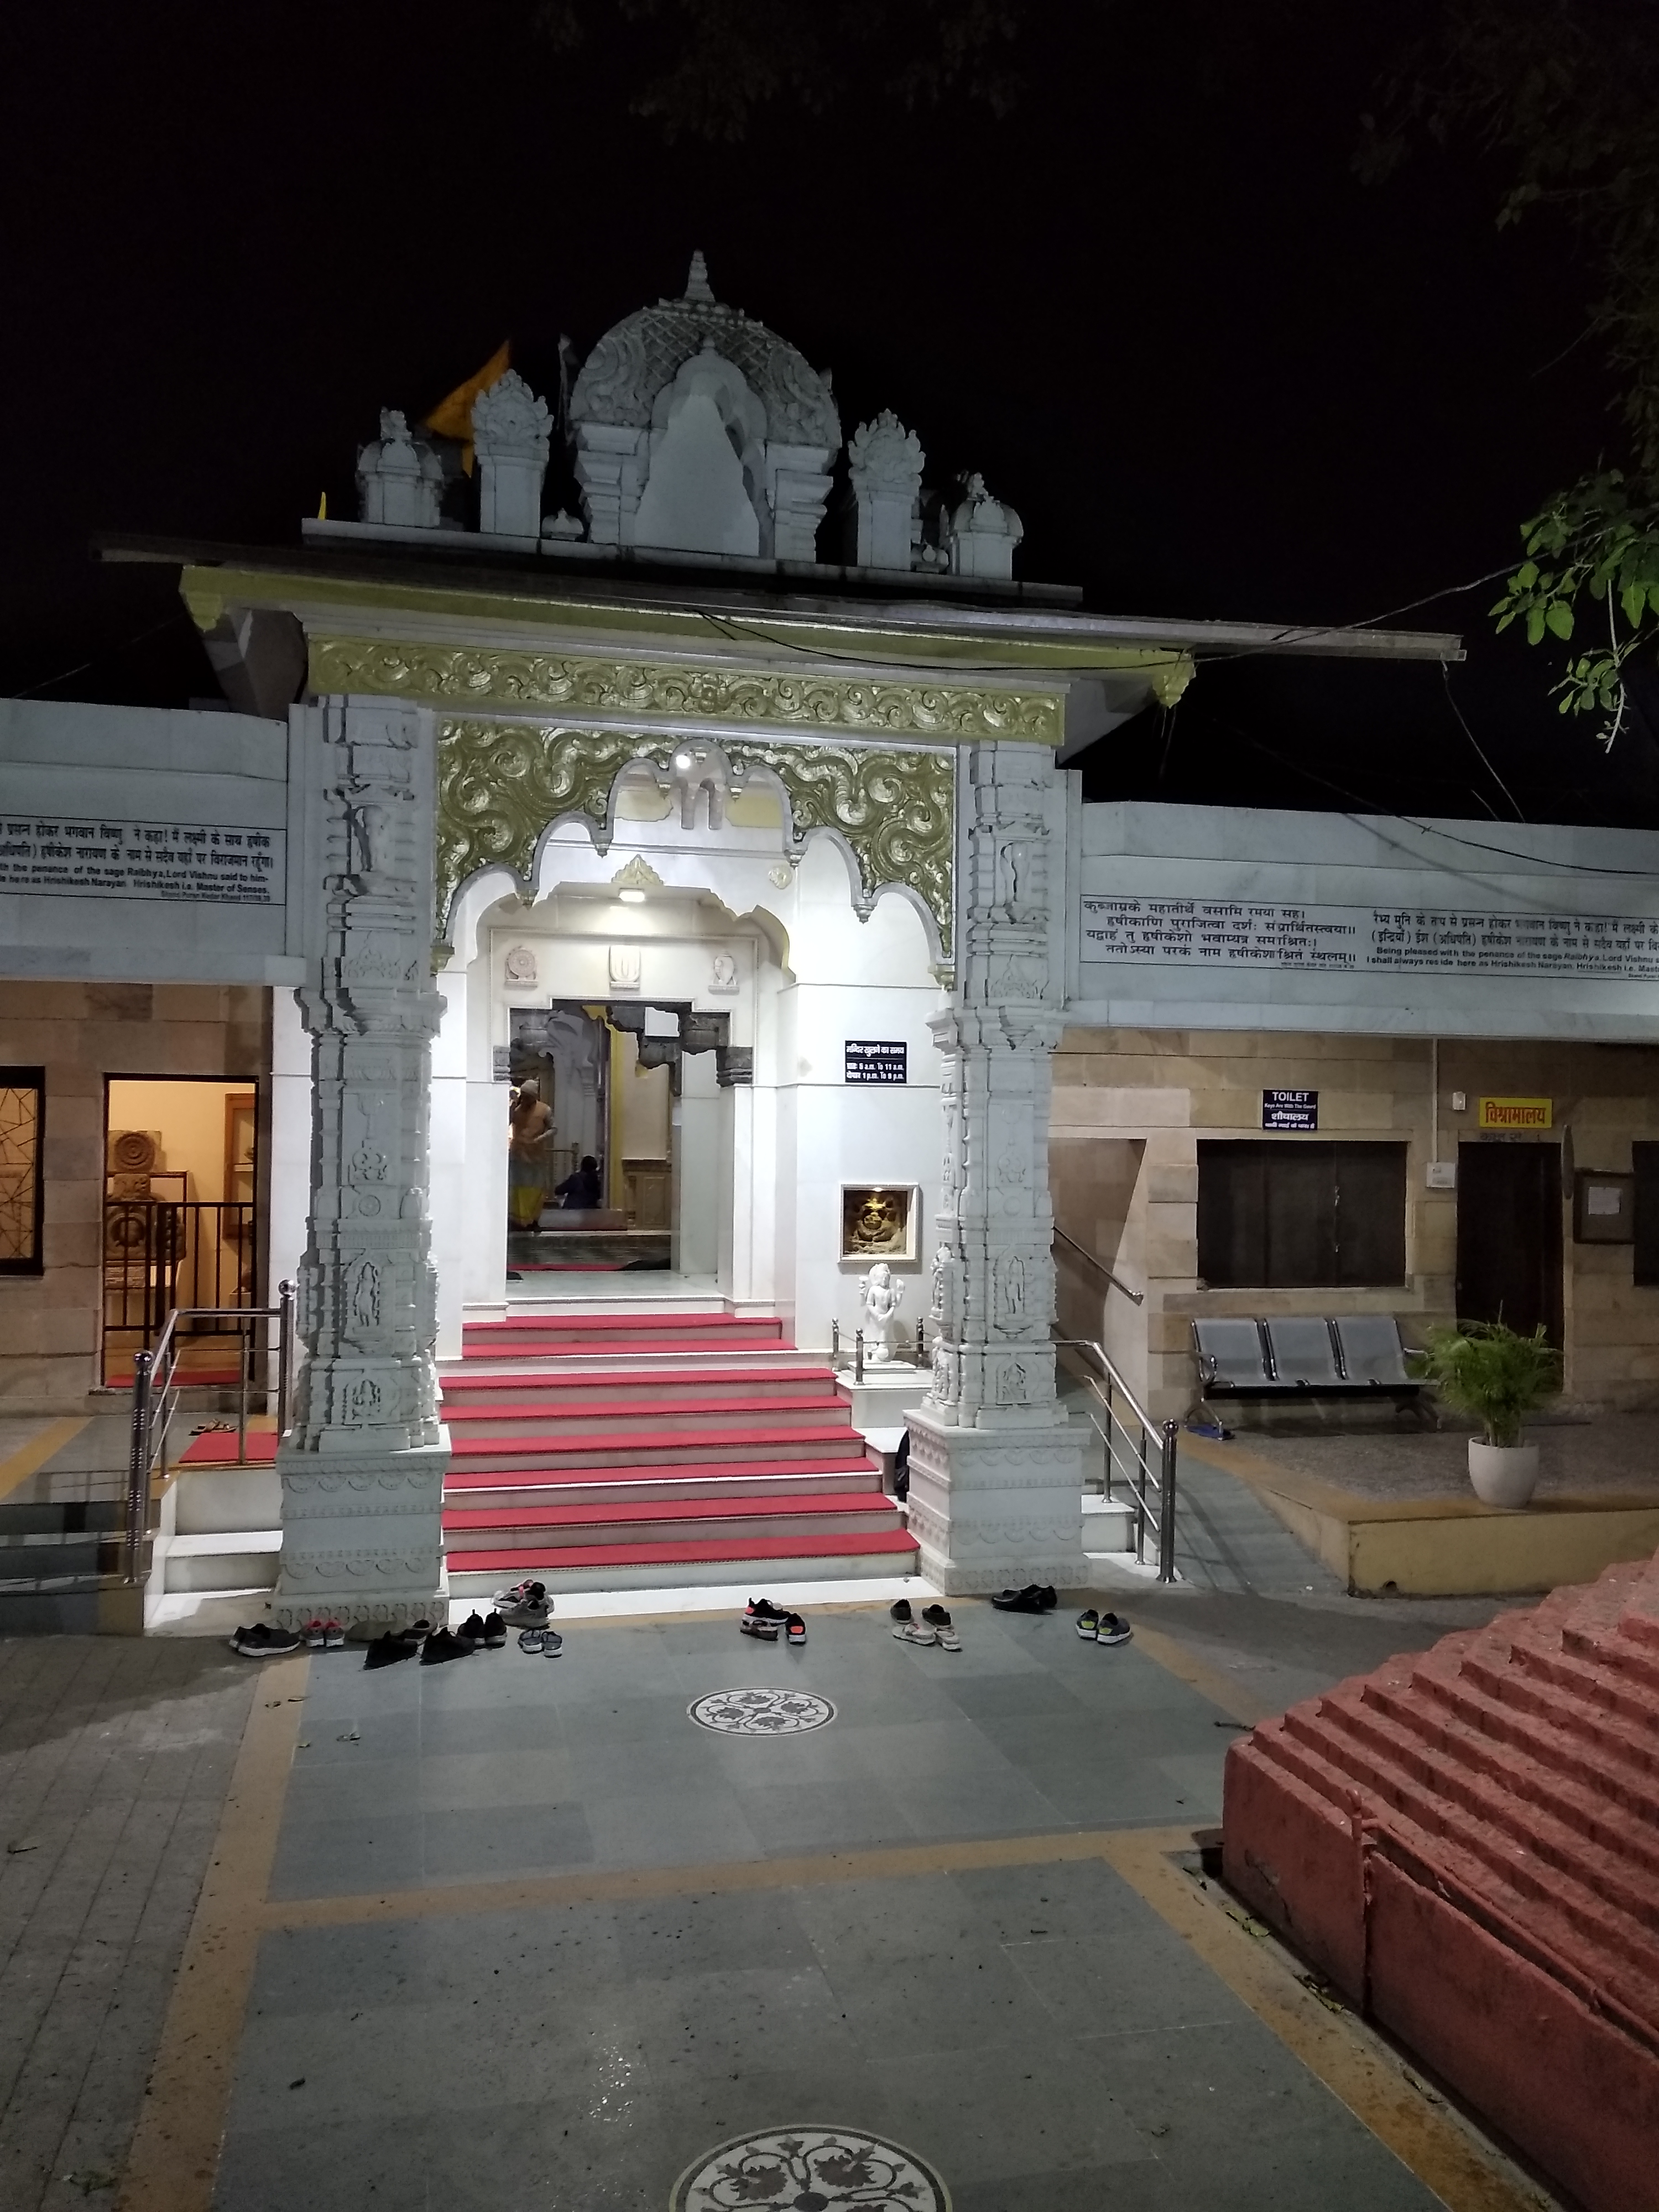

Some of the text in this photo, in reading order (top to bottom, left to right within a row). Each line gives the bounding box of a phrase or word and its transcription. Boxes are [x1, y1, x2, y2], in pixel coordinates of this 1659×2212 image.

[1202, 905, 1242, 916] वसामि
[1248, 908, 1275, 917] रमया
[1125, 931, 1135, 943] तु
[1198, 948, 1220, 957] नाम
[1377, 947, 1402, 956] Being
[1394, 957, 1423, 967] always
[1272, 1092, 1309, 1102] TOILET
